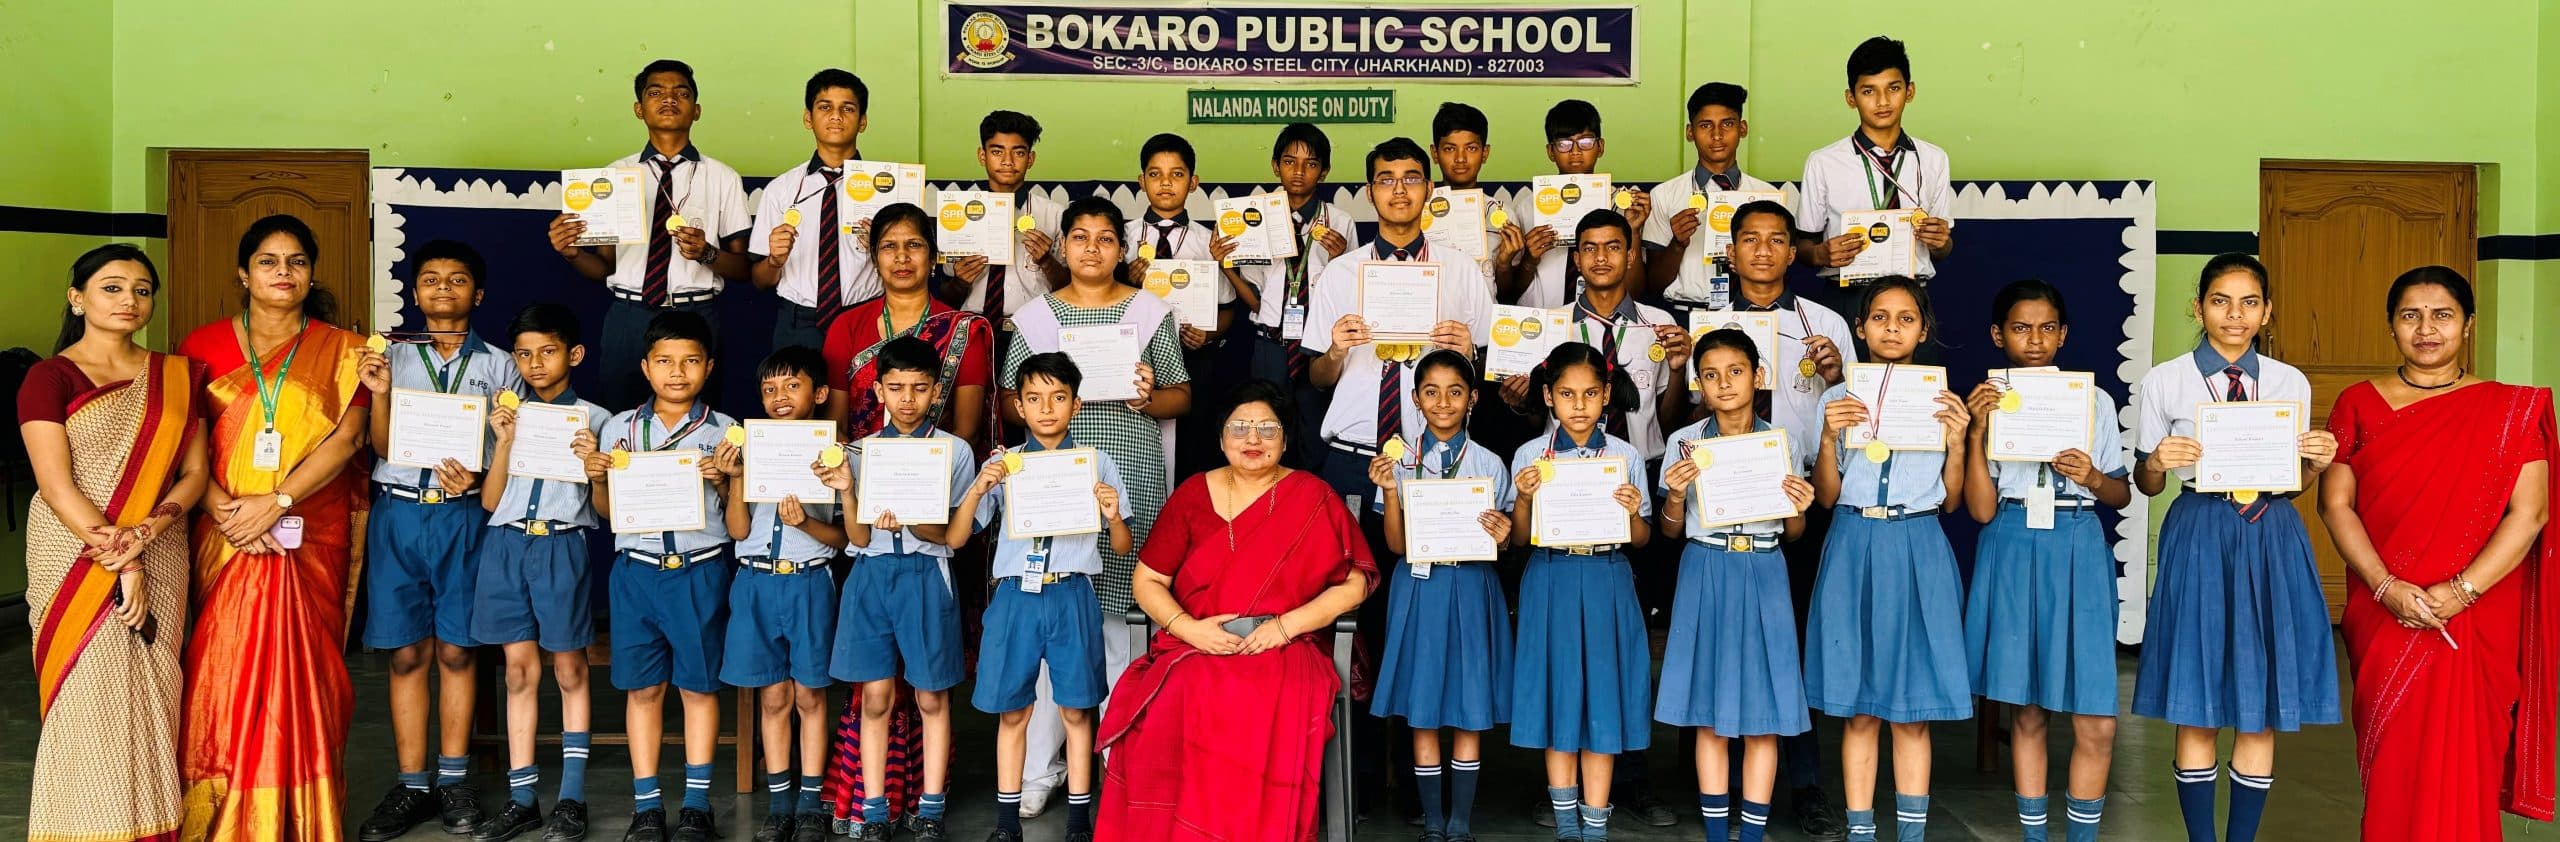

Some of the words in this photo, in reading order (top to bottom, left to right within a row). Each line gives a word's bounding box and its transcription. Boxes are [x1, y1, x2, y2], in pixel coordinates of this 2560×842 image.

[1026, 14, 1220, 51] BOKARO
[1236, 16, 1404, 53] PUBLIC
[1420, 16, 1611, 53] SCHOOL
[1092, 56, 1168, 73] SEC.-3/C,
[1173, 57, 1248, 72] BOKARO
[1252, 58, 1307, 72] STEEL
[1311, 58, 1350, 73] CITY
[1354, 58, 1473, 76] (JHARKHAND)
[1487, 59, 1545, 73] 827003
[1192, 97, 1262, 118] NALANDA
[1267, 97, 1318, 118] HOUSE
[1322, 97, 1344, 118] ON
[1349, 97, 1389, 118] DUTY
[567, 188, 589, 199] SPR
[1538, 194, 1560, 203] SPR
[943, 210, 964, 218] SPR
